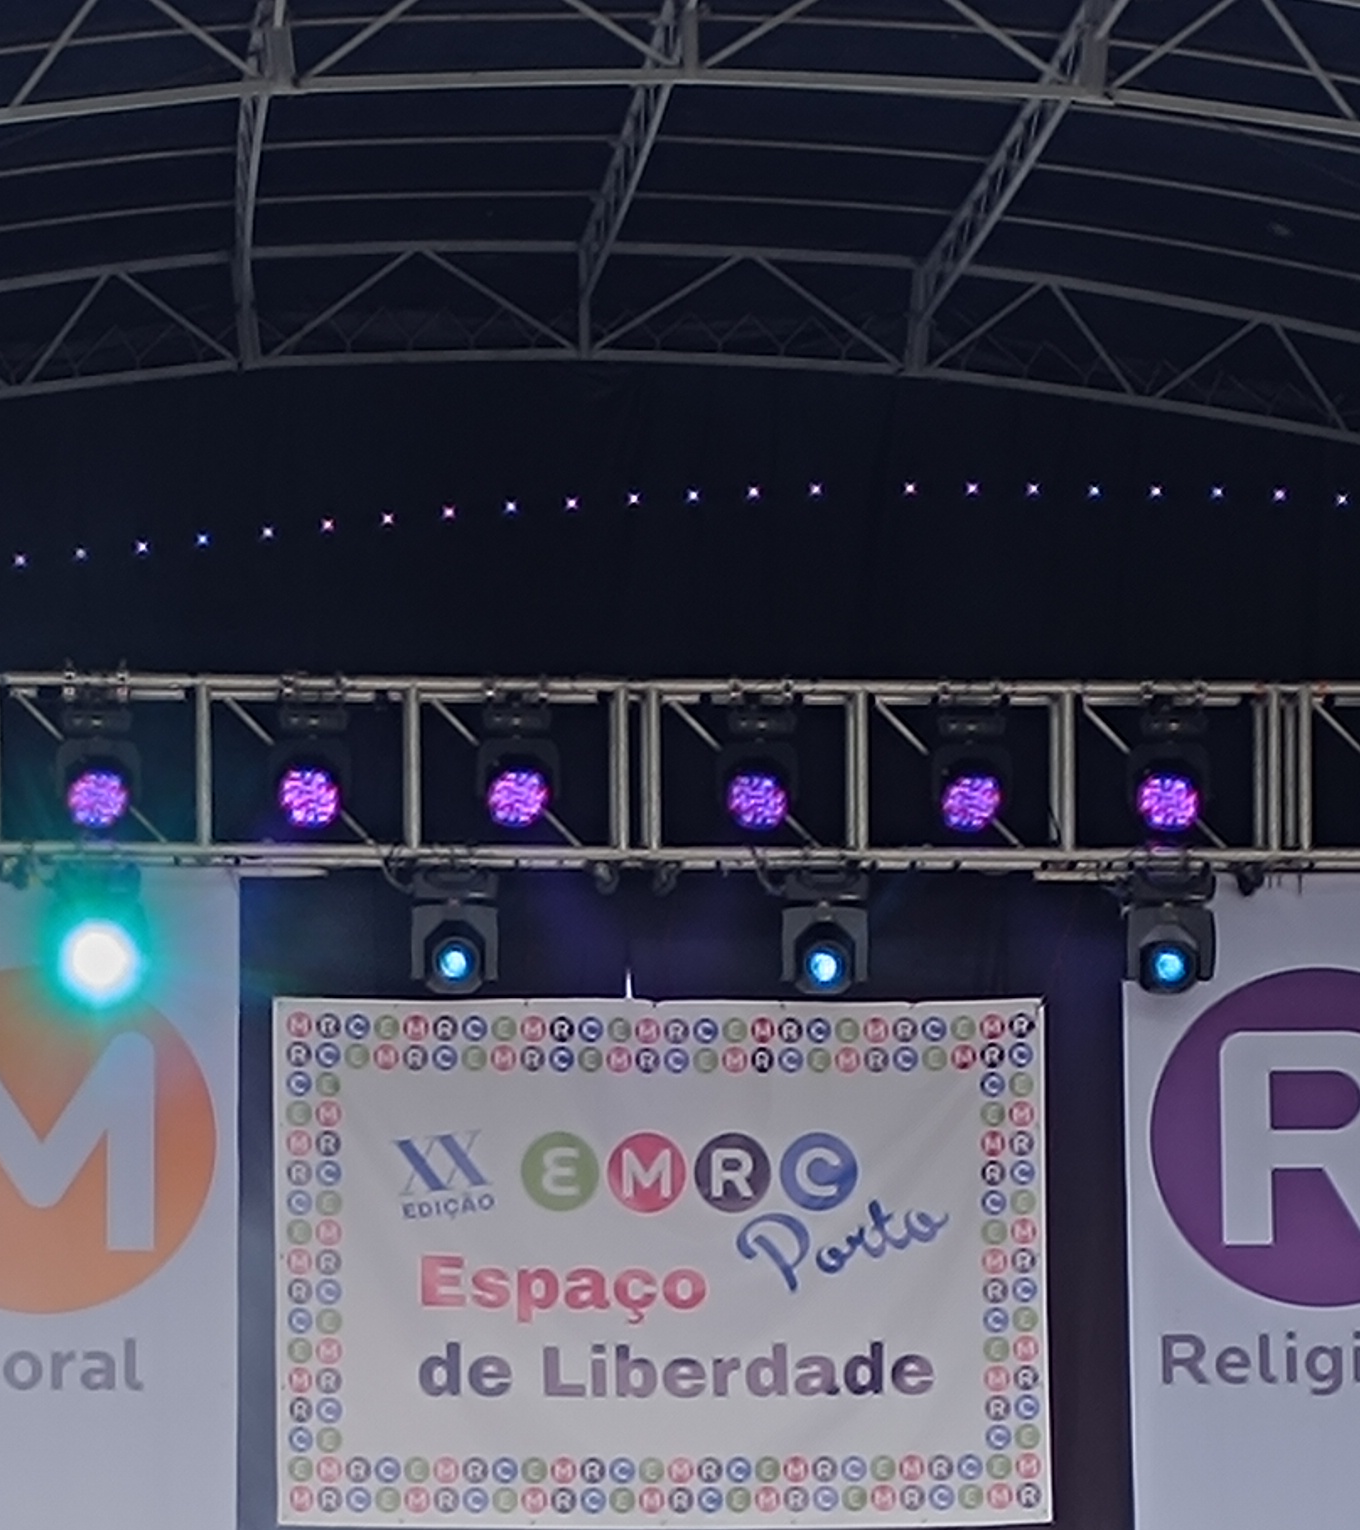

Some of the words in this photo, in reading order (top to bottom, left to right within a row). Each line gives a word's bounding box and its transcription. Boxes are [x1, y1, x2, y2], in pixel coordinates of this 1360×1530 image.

[392, 1130, 493, 1196] XX
[536, 1143, 846, 1203] EMRC
[403, 1191, 495, 1219] EDIÇÃO
[736, 1200, 949, 1292] Porto
[420, 1255, 707, 1324] Espaço
[419, 1341, 512, 1396] de
[543, 1341, 935, 1397] Liberdade
